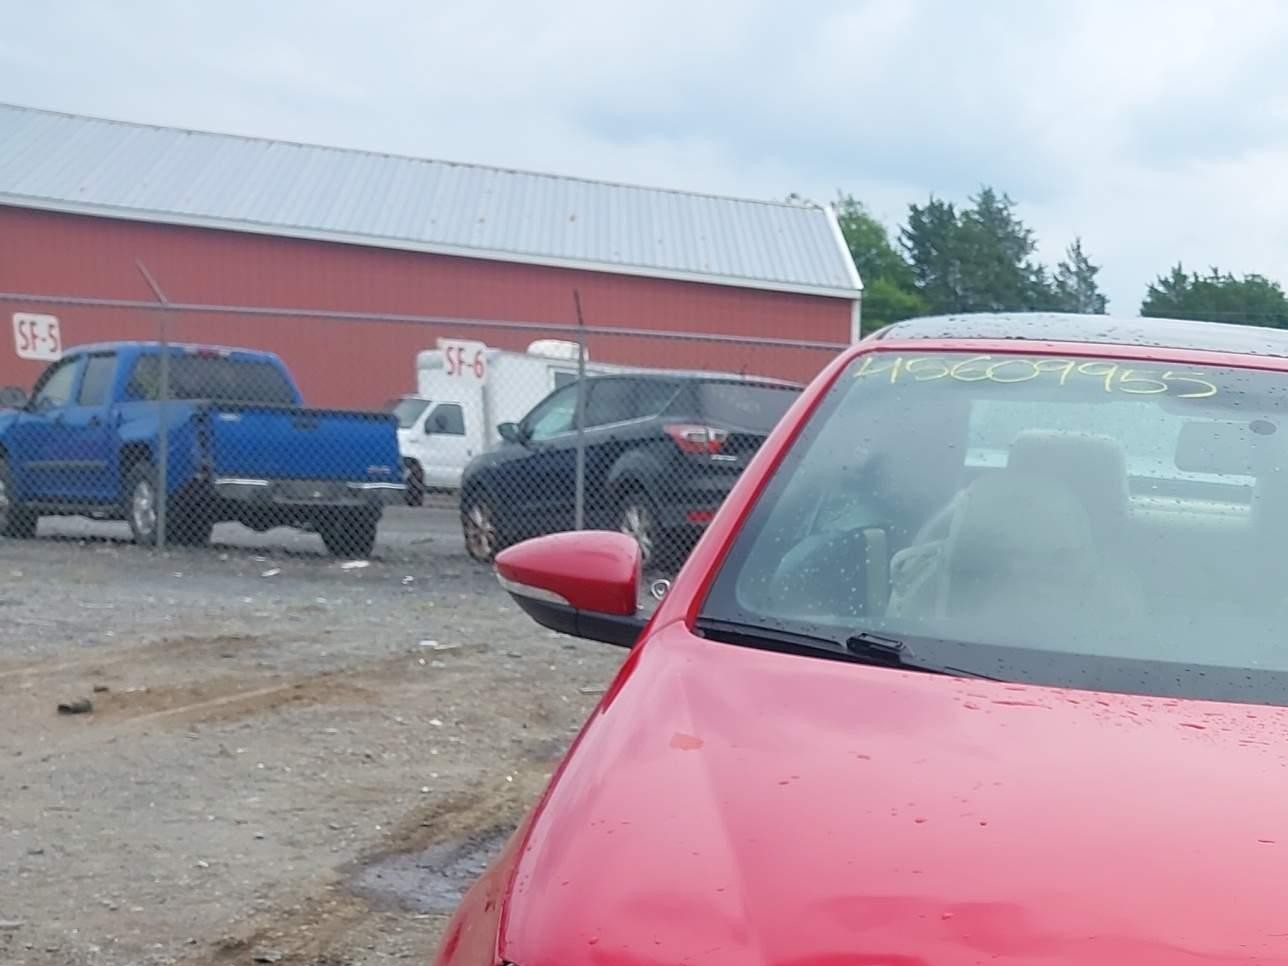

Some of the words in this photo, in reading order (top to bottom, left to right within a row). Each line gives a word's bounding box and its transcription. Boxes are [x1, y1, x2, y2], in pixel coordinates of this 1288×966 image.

[18, 320, 58, 353] SF-5
[446, 346, 485, 378] SF-6
[854, 355, 1218, 399] 45609955
